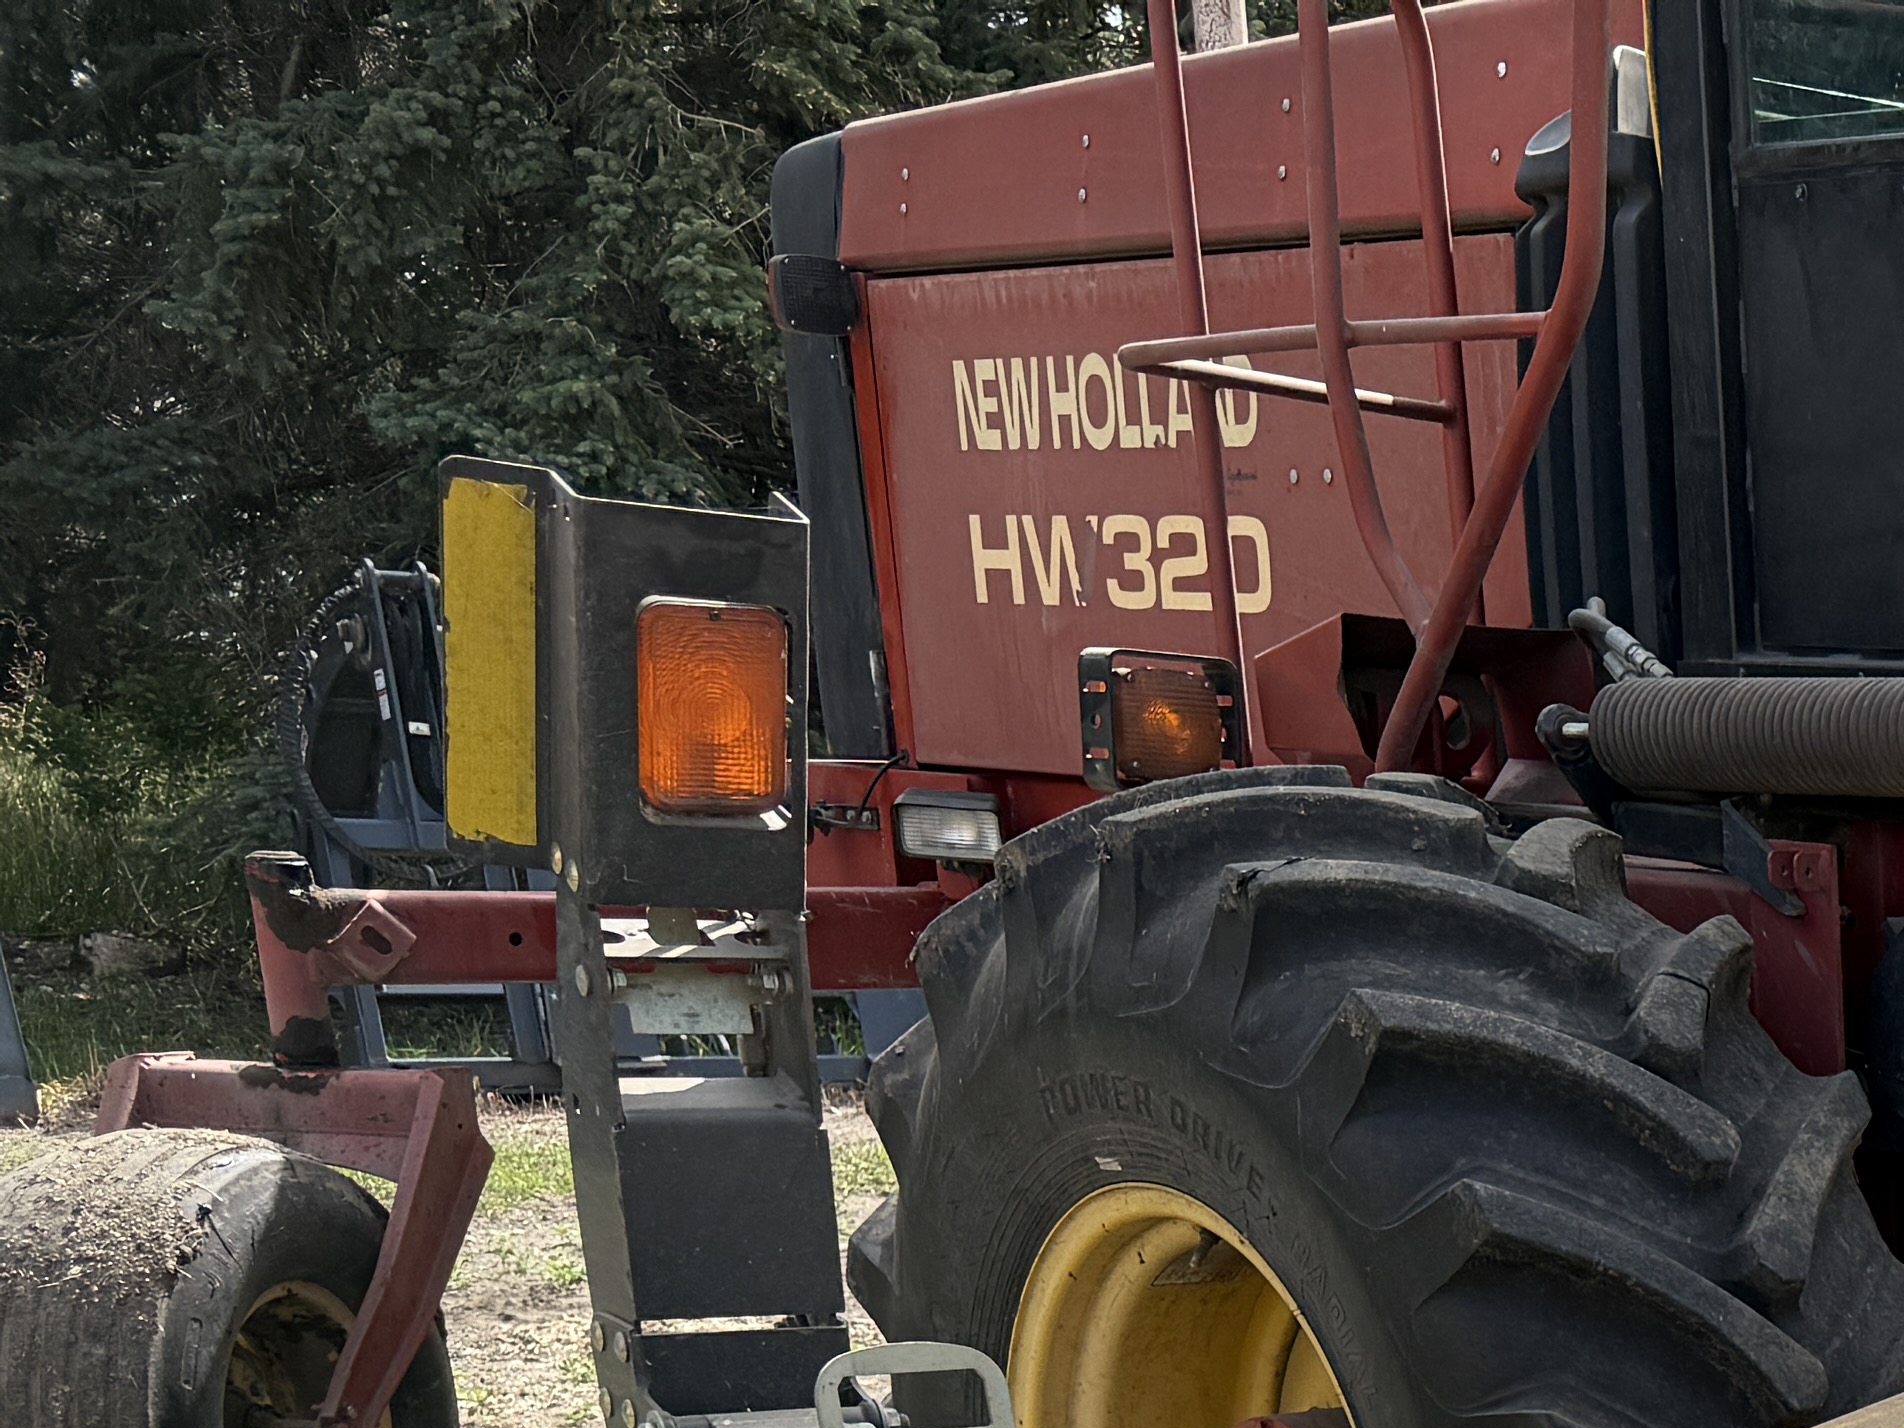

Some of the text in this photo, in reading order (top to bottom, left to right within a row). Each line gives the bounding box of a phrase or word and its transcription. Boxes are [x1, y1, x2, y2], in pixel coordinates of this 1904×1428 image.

[953, 352, 1258, 451] NEW HOLLAD
[1038, 1070, 1265, 1202] POWER DRIVE
